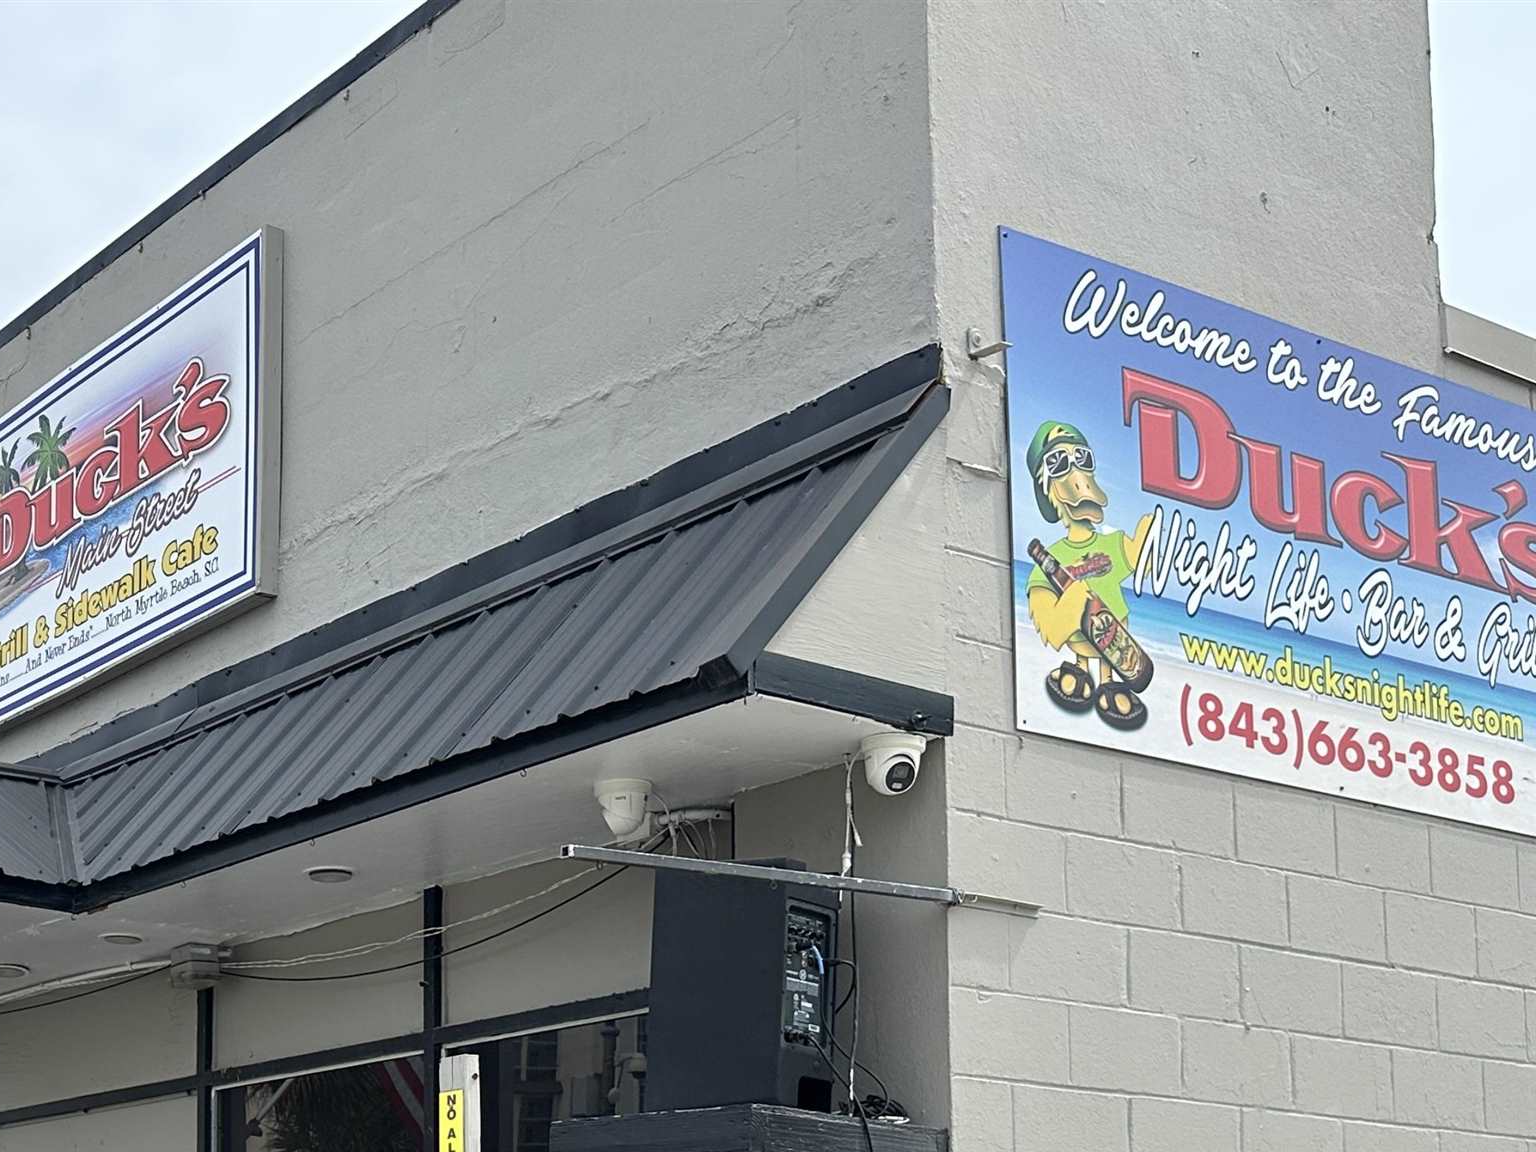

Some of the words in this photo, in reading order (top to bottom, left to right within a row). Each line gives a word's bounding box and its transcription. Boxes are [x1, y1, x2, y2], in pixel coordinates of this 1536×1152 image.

[1064, 269, 1257, 374] Welcome
[1266, 340, 1308, 391] to
[1316, 358, 1382, 414] the
[1393, 385, 1536, 473] Famous
[55, 535, 124, 599] Main
[125, 467, 202, 558] Street
[1121, 366, 1536, 603] Duck's
[33, 615, 50, 649] &
[54, 555, 156, 638] Sidewalk
[161, 524, 219, 577] Cafe
[44, 643, 67, 664] Never
[135, 587, 168, 614] Myrtle
[1134, 505, 1257, 616] Night
[1265, 541, 1334, 635] Life
[1356, 568, 1431, 657] Bar
[1434, 595, 1467, 662] &
[1180, 631, 1524, 742] www.ducksnightlife.com
[1180, 683, 1516, 805] (843)663-3858
[445, 1094, 457, 1120] NO
